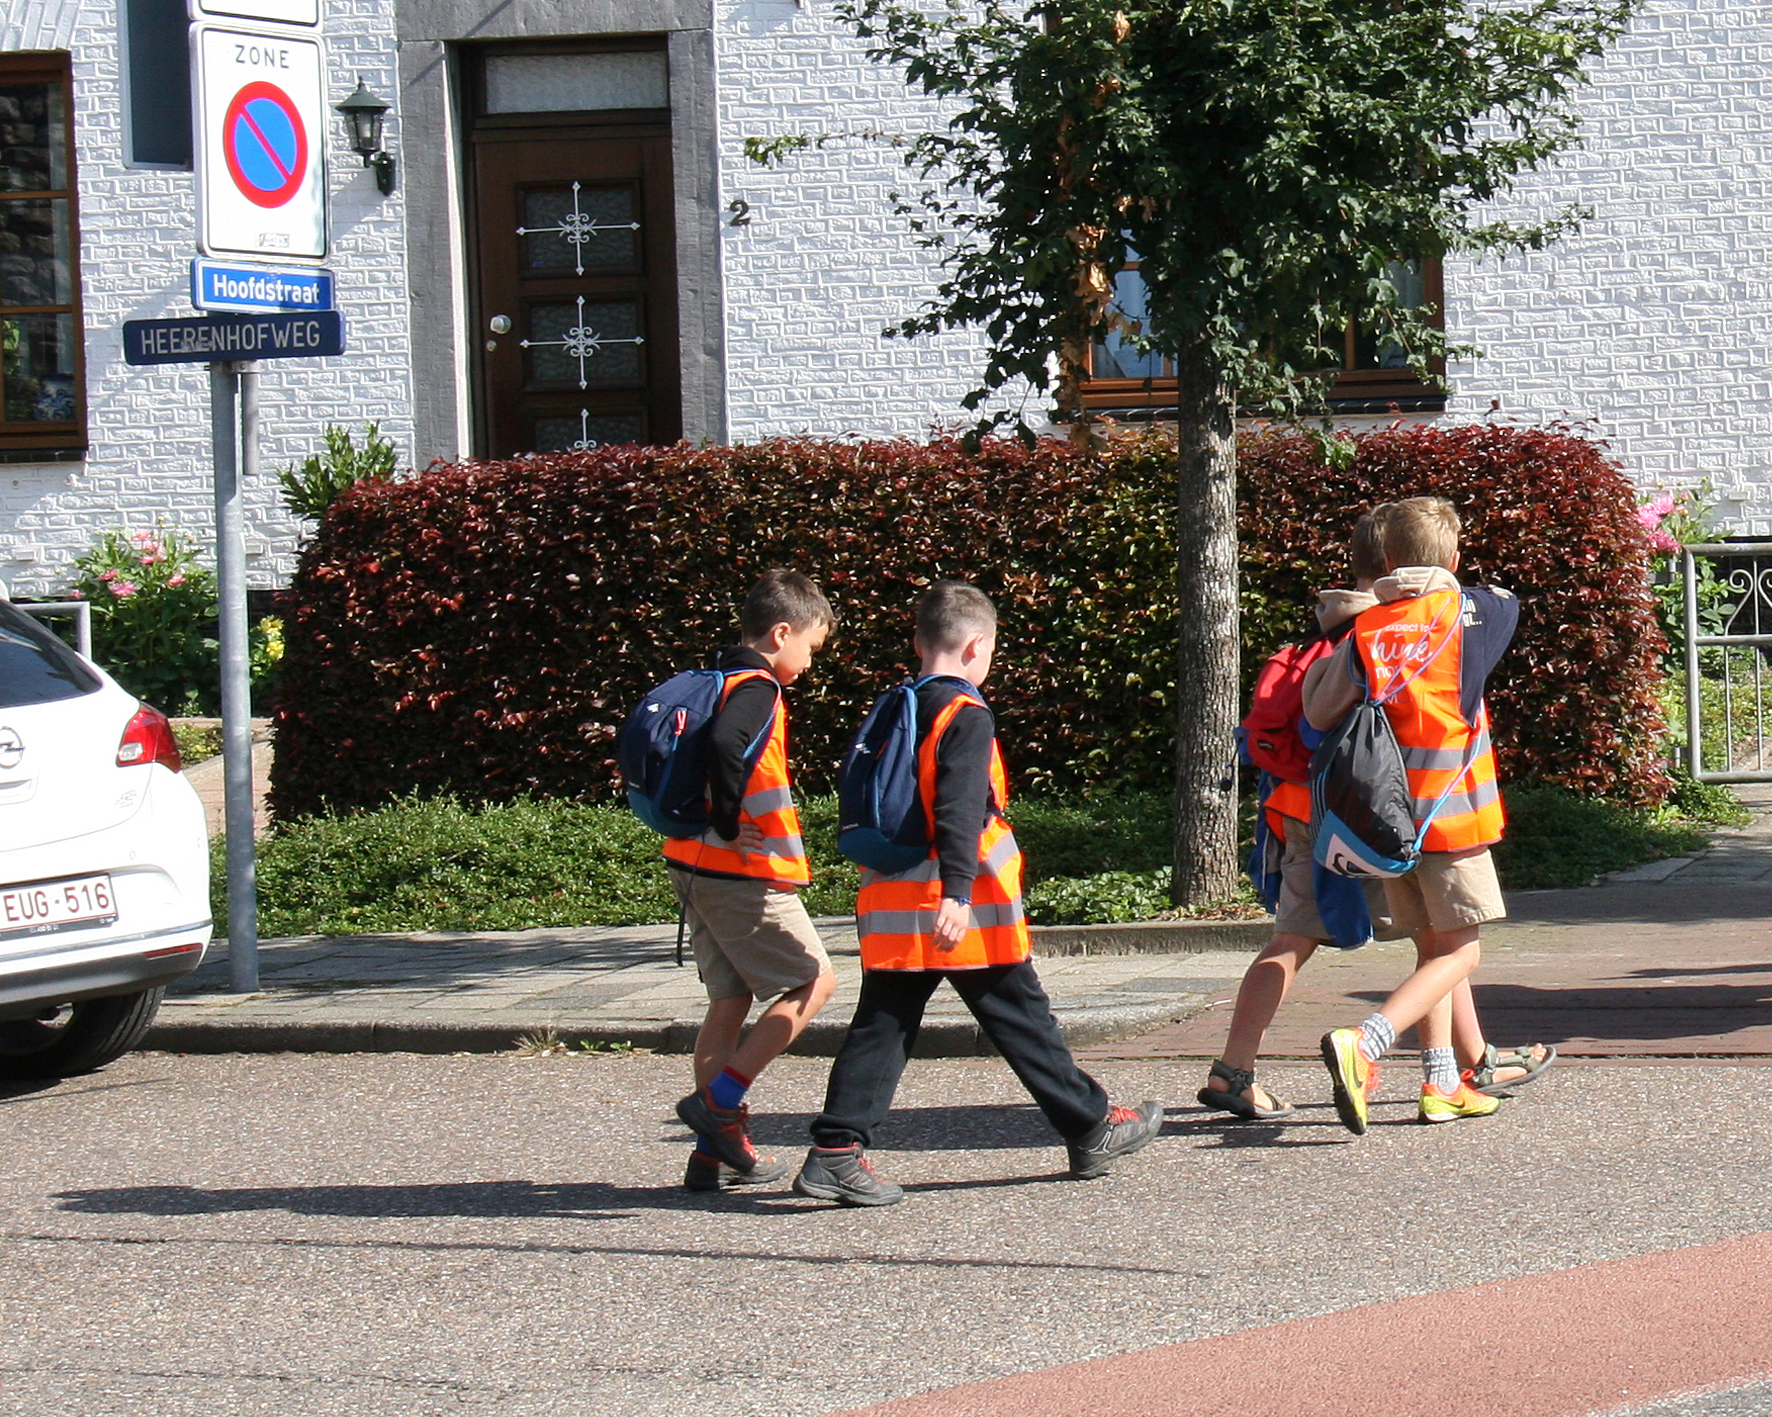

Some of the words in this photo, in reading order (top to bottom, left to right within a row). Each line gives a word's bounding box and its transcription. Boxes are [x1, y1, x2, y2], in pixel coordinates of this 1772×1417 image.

[234, 43, 290, 69] ZONE
[729, 199, 751, 226] 2
[213, 273, 320, 304] Hoofdstraat
[141, 320, 320, 356] HEERENHOFWEG
